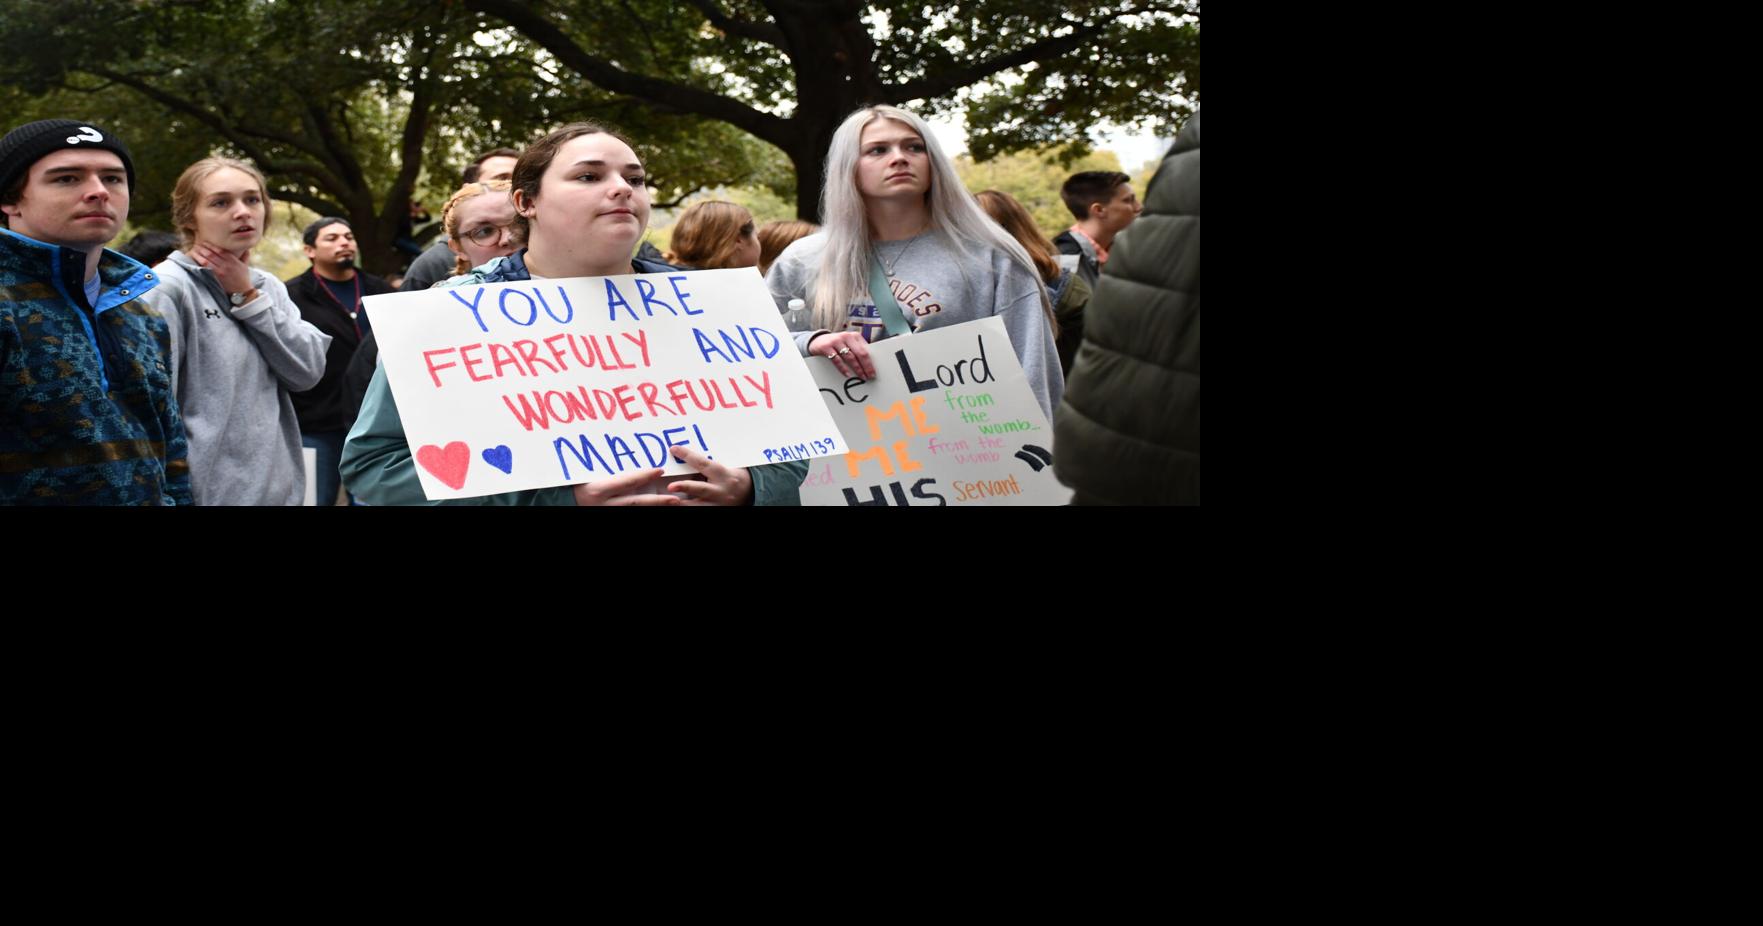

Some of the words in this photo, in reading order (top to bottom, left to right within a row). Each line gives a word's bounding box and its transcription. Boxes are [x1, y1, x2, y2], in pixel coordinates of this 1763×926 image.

[449, 285, 574, 333] YOU
[604, 276, 704, 322] ARE
[422, 329, 651, 388] FEARFULLY
[692, 325, 781, 364] AND
[894, 334, 996, 394] Lord
[502, 371, 774, 432] WONDERFULLY
[864, 396, 941, 441] ME
[944, 389, 995, 411] from
[961, 411, 988, 424] the
[553, 424, 713, 481] MADE!
[763, 443, 811, 462] PSALM
[809, 437, 836, 455] 139
[844, 441, 923, 478] ME
[928, 437, 969, 455] from
[977, 435, 1005, 449] the
[954, 451, 1001, 465] womb
[842, 478, 947, 506] HIS
